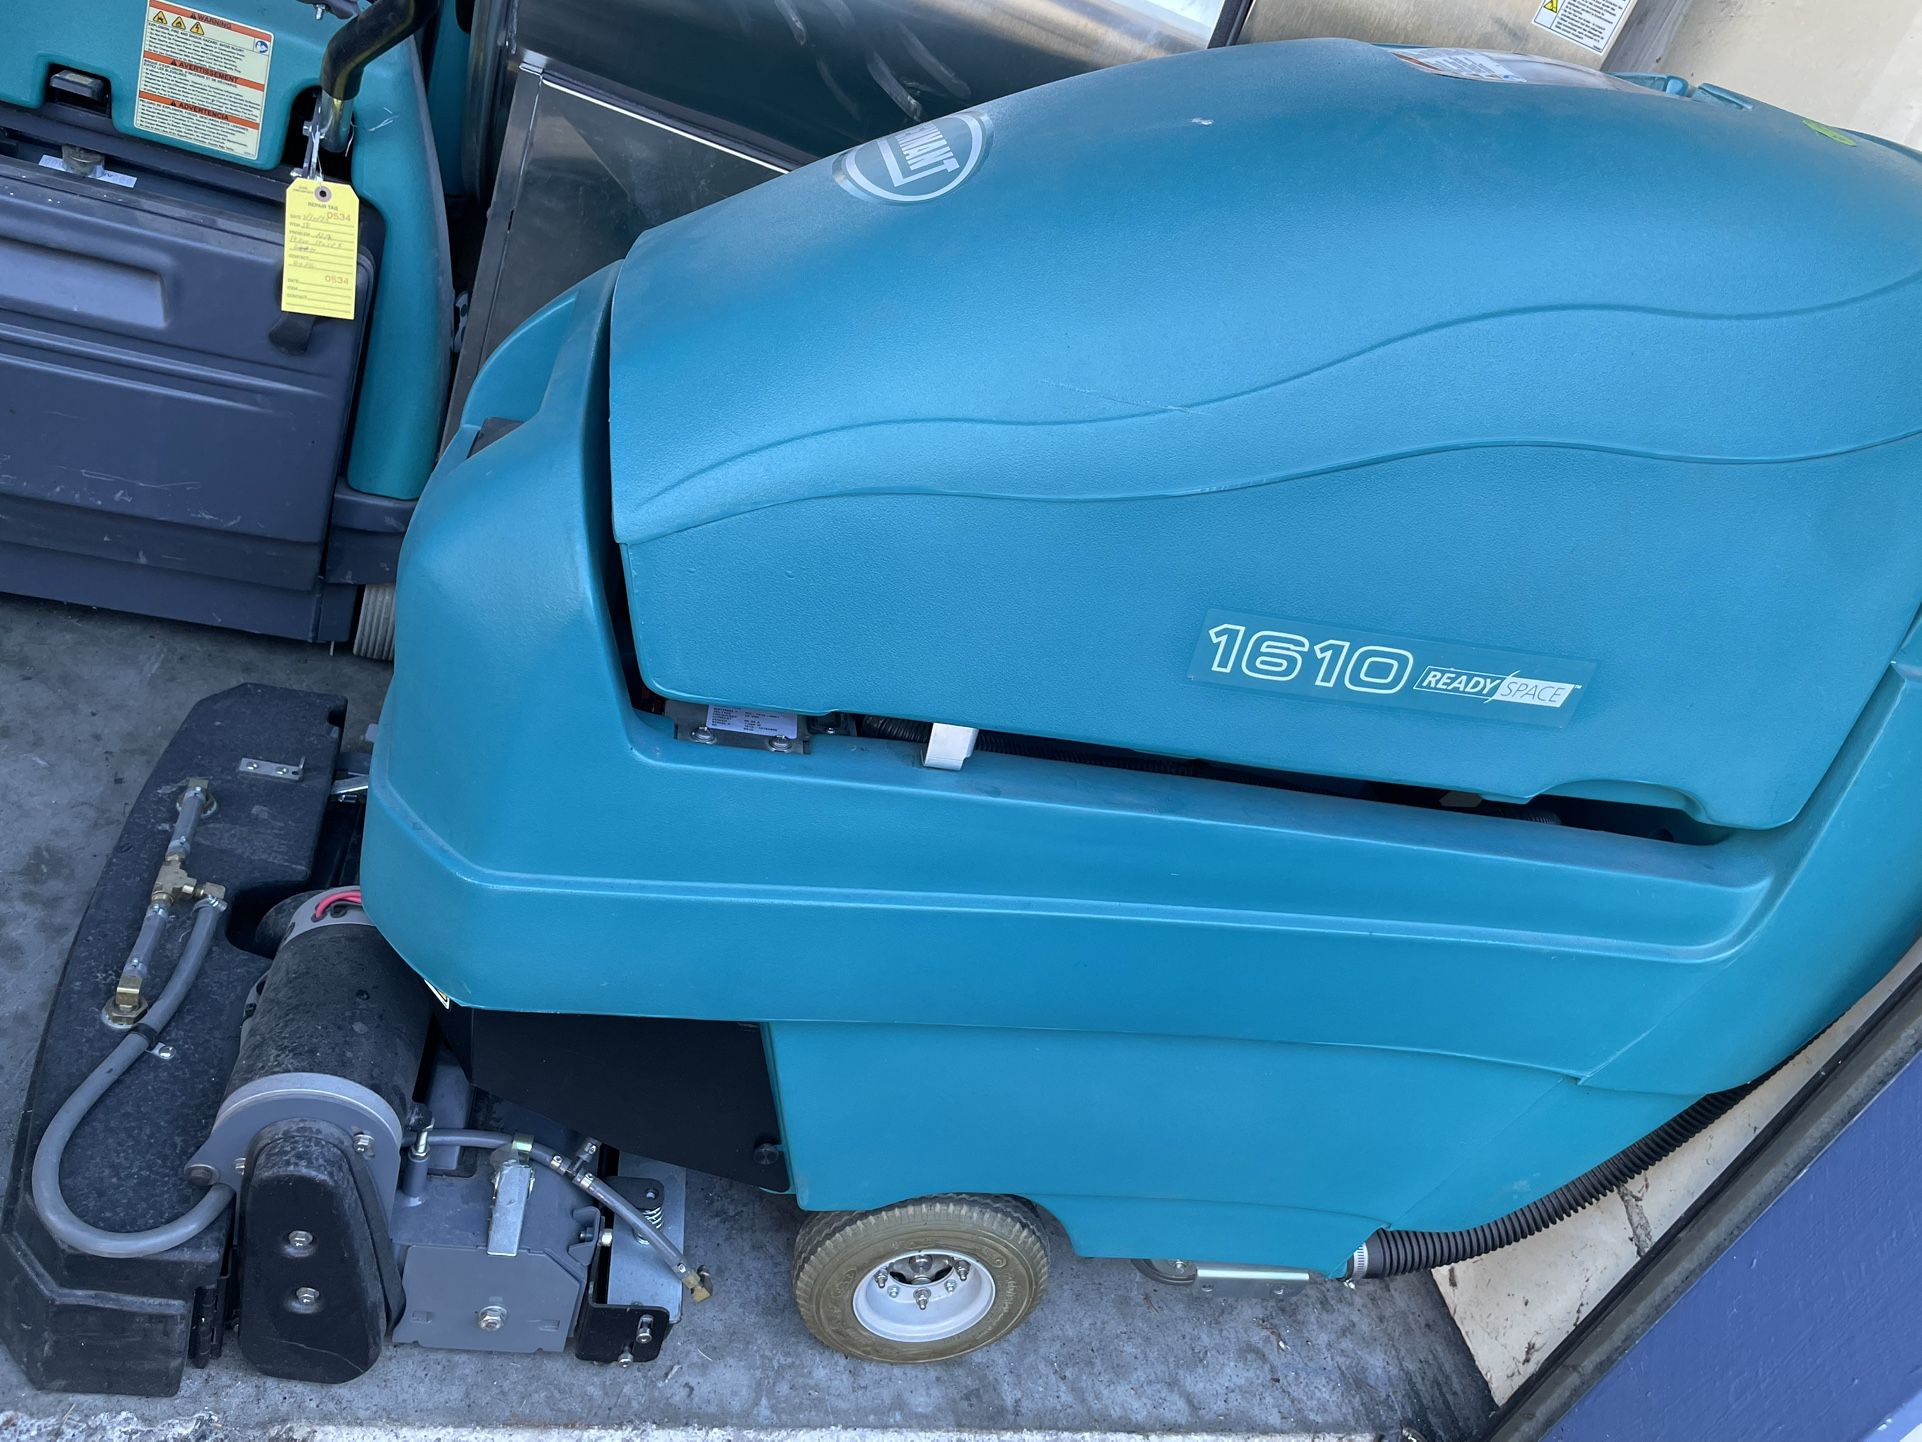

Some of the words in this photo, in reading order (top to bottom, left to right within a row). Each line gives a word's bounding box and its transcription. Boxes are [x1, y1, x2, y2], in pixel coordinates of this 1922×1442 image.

[197, 13, 232, 30] WARNING
[179, 62, 238, 83] AVERTISSEMENT
[179, 103, 229, 121] ADVERTENCIA
[326, 211, 351, 222] 0534
[325, 275, 349, 285] 0534
[1208, 623, 1414, 695] 1610
[1422, 671, 1502, 695] READY
[1500, 681, 1566, 703] SPACE
